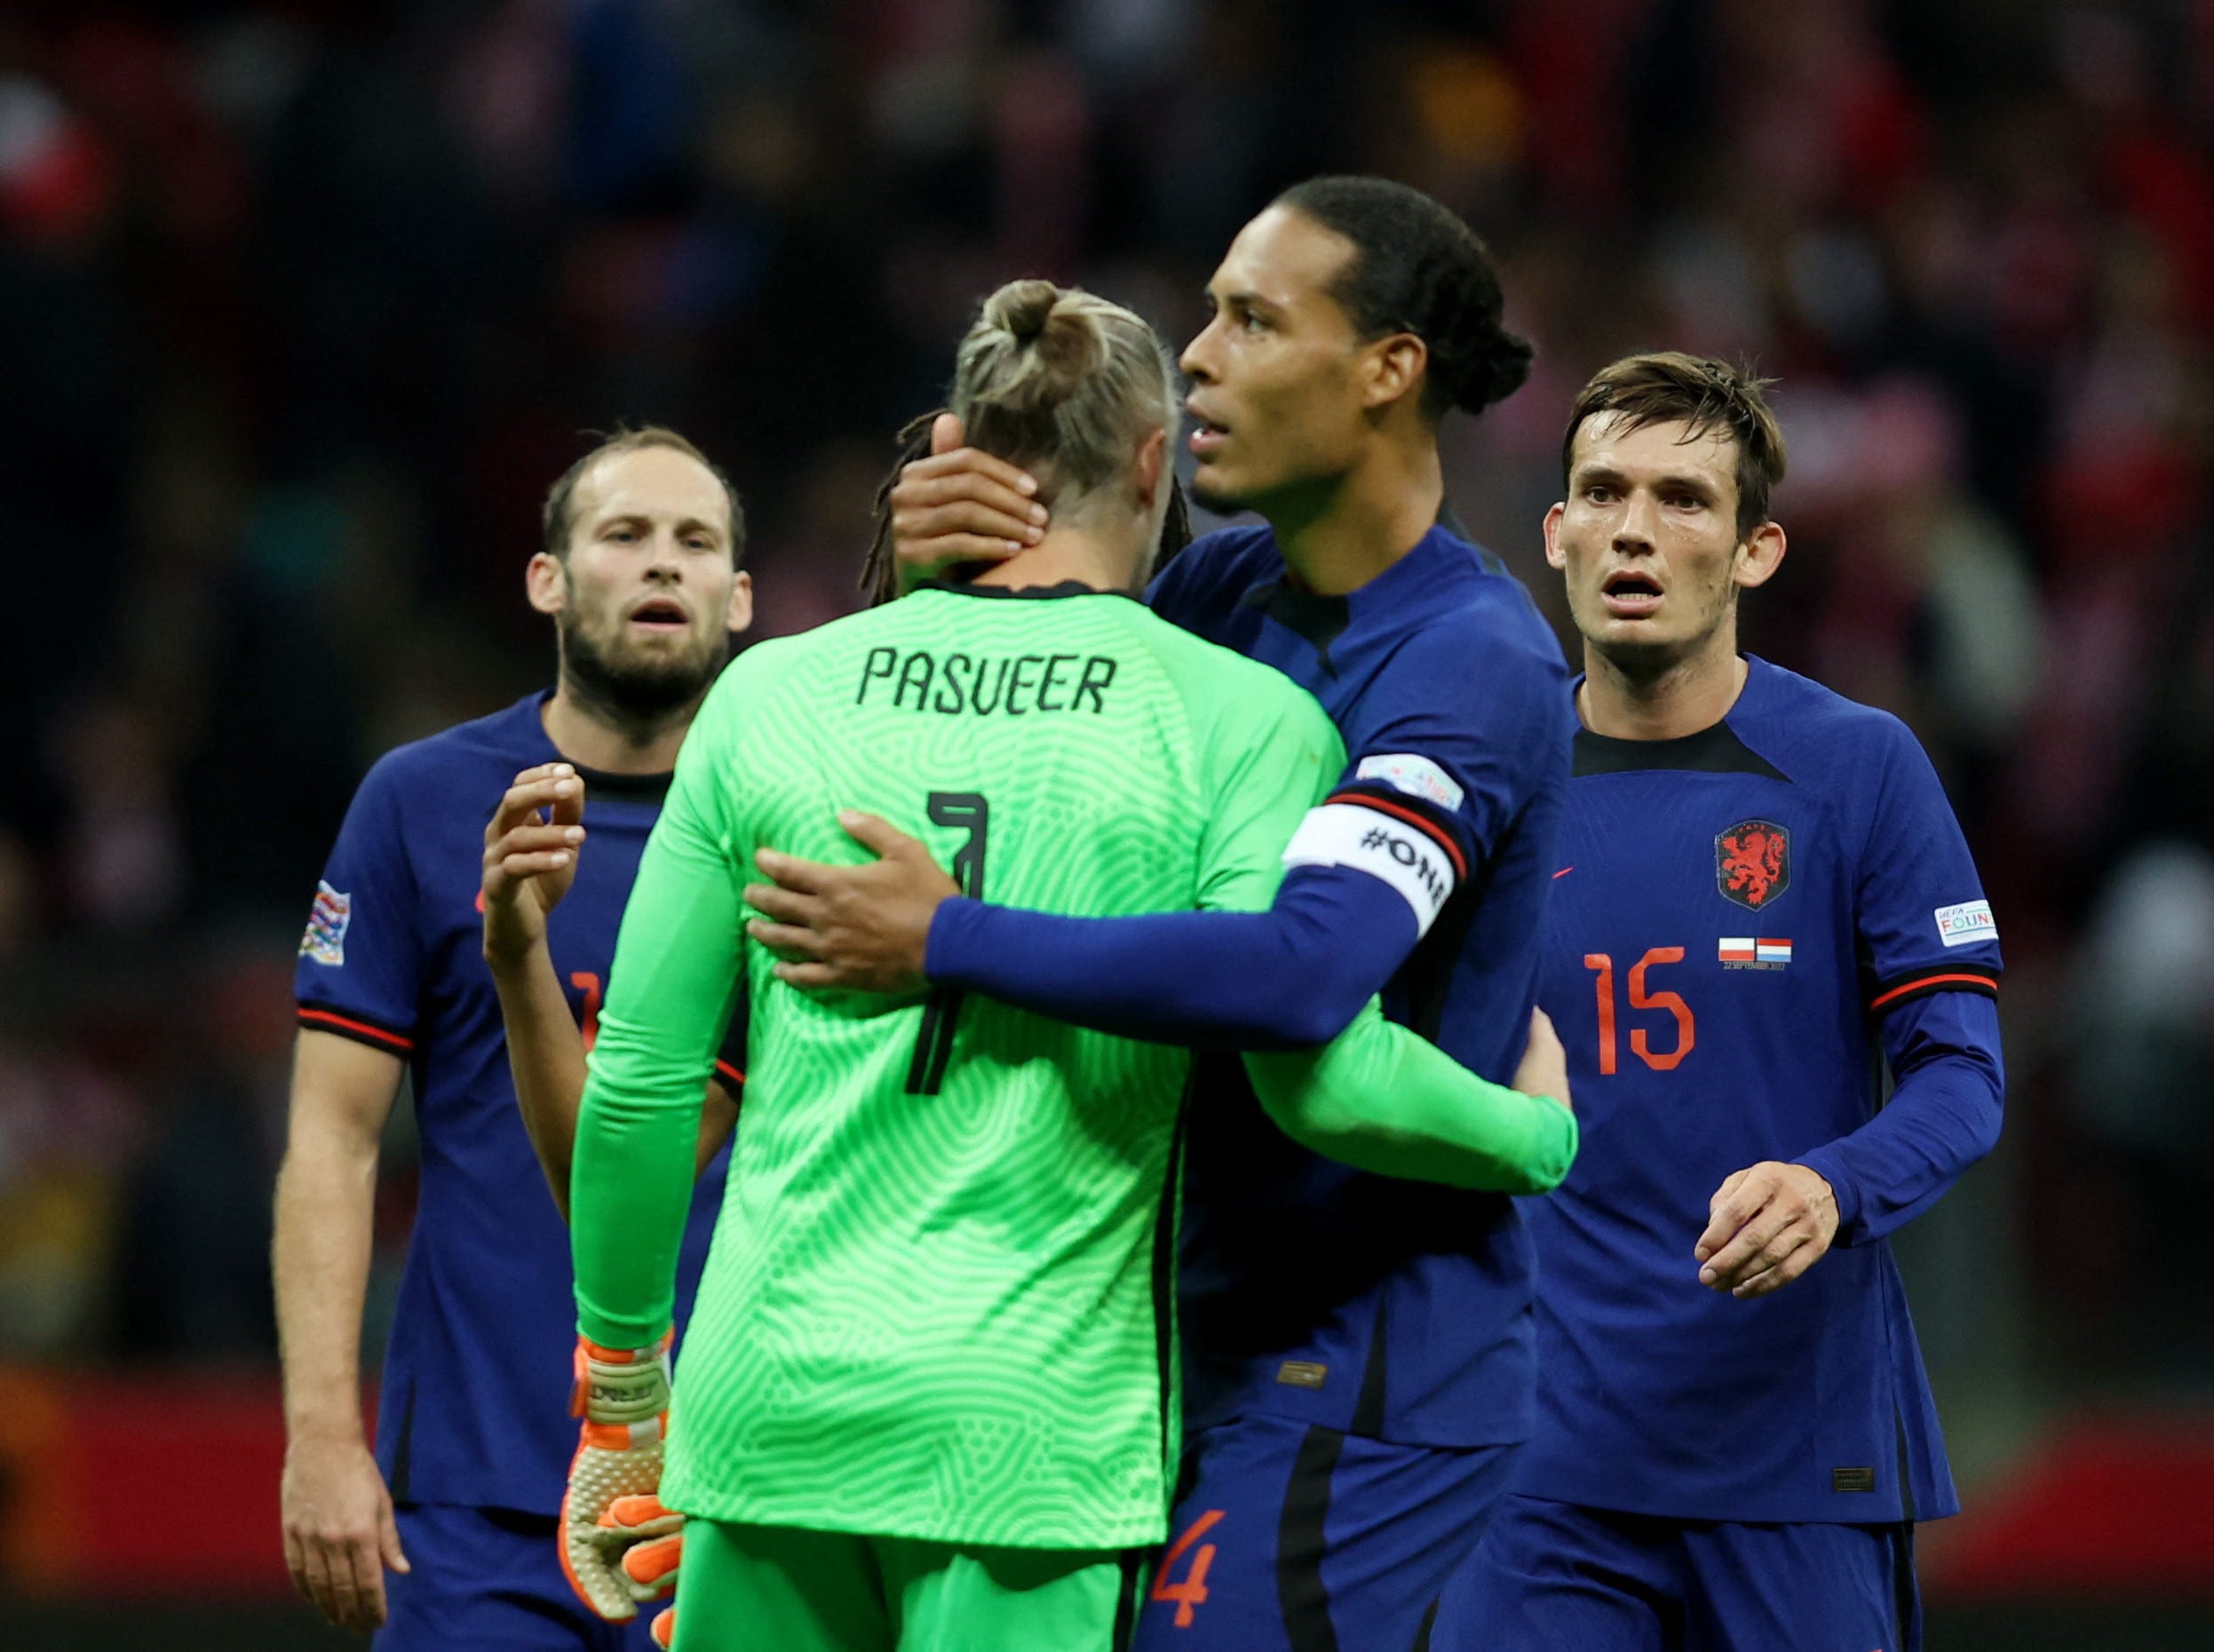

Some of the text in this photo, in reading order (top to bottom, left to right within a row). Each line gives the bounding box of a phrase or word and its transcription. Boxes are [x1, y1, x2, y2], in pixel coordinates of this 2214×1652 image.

[856, 647, 1118, 715] PASVEER
[1939, 908, 1964, 919] UEFA
[1941, 912, 1993, 933] FOUN
[1583, 946, 1694, 1075] 15
[1151, 1509, 1226, 1628] 4
